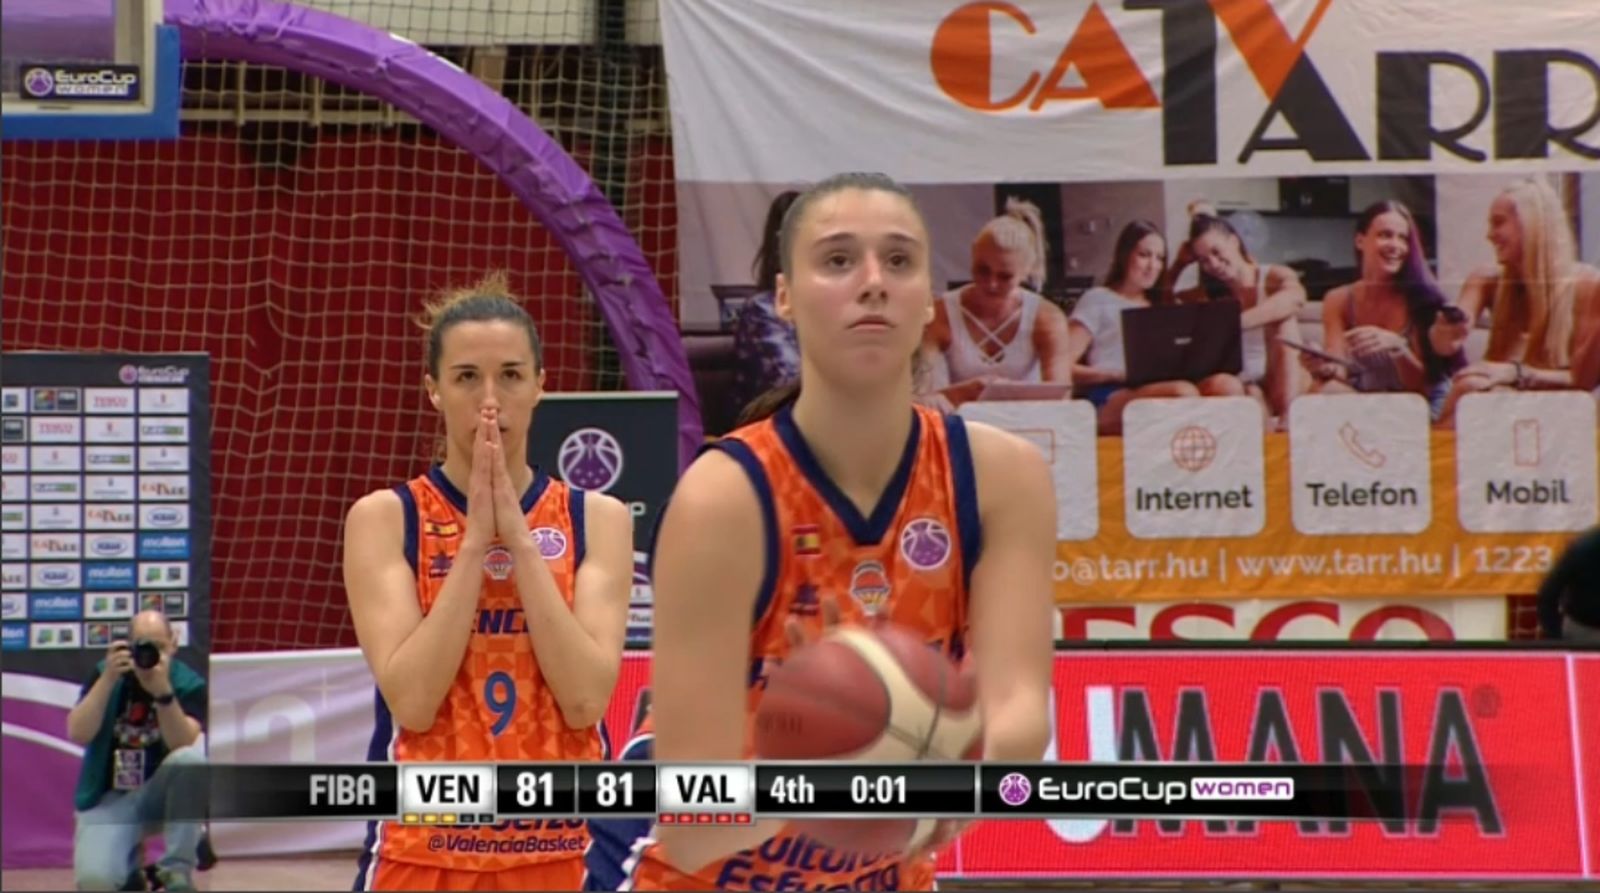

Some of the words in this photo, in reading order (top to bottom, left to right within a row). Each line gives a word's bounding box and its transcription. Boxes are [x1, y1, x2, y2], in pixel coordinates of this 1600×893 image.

[55, 69, 137, 84] EuroCup
[1135, 484, 1254, 511] Internet
[1306, 482, 1419, 508] Telefon
[1485, 479, 1570, 505] Mobil
[1236, 547, 1443, 579] www.tarr.hu
[1474, 546, 1553, 573] 1223
[483, 671, 517, 737] 9
[427, 833, 586, 853] @ValenciaBasket
